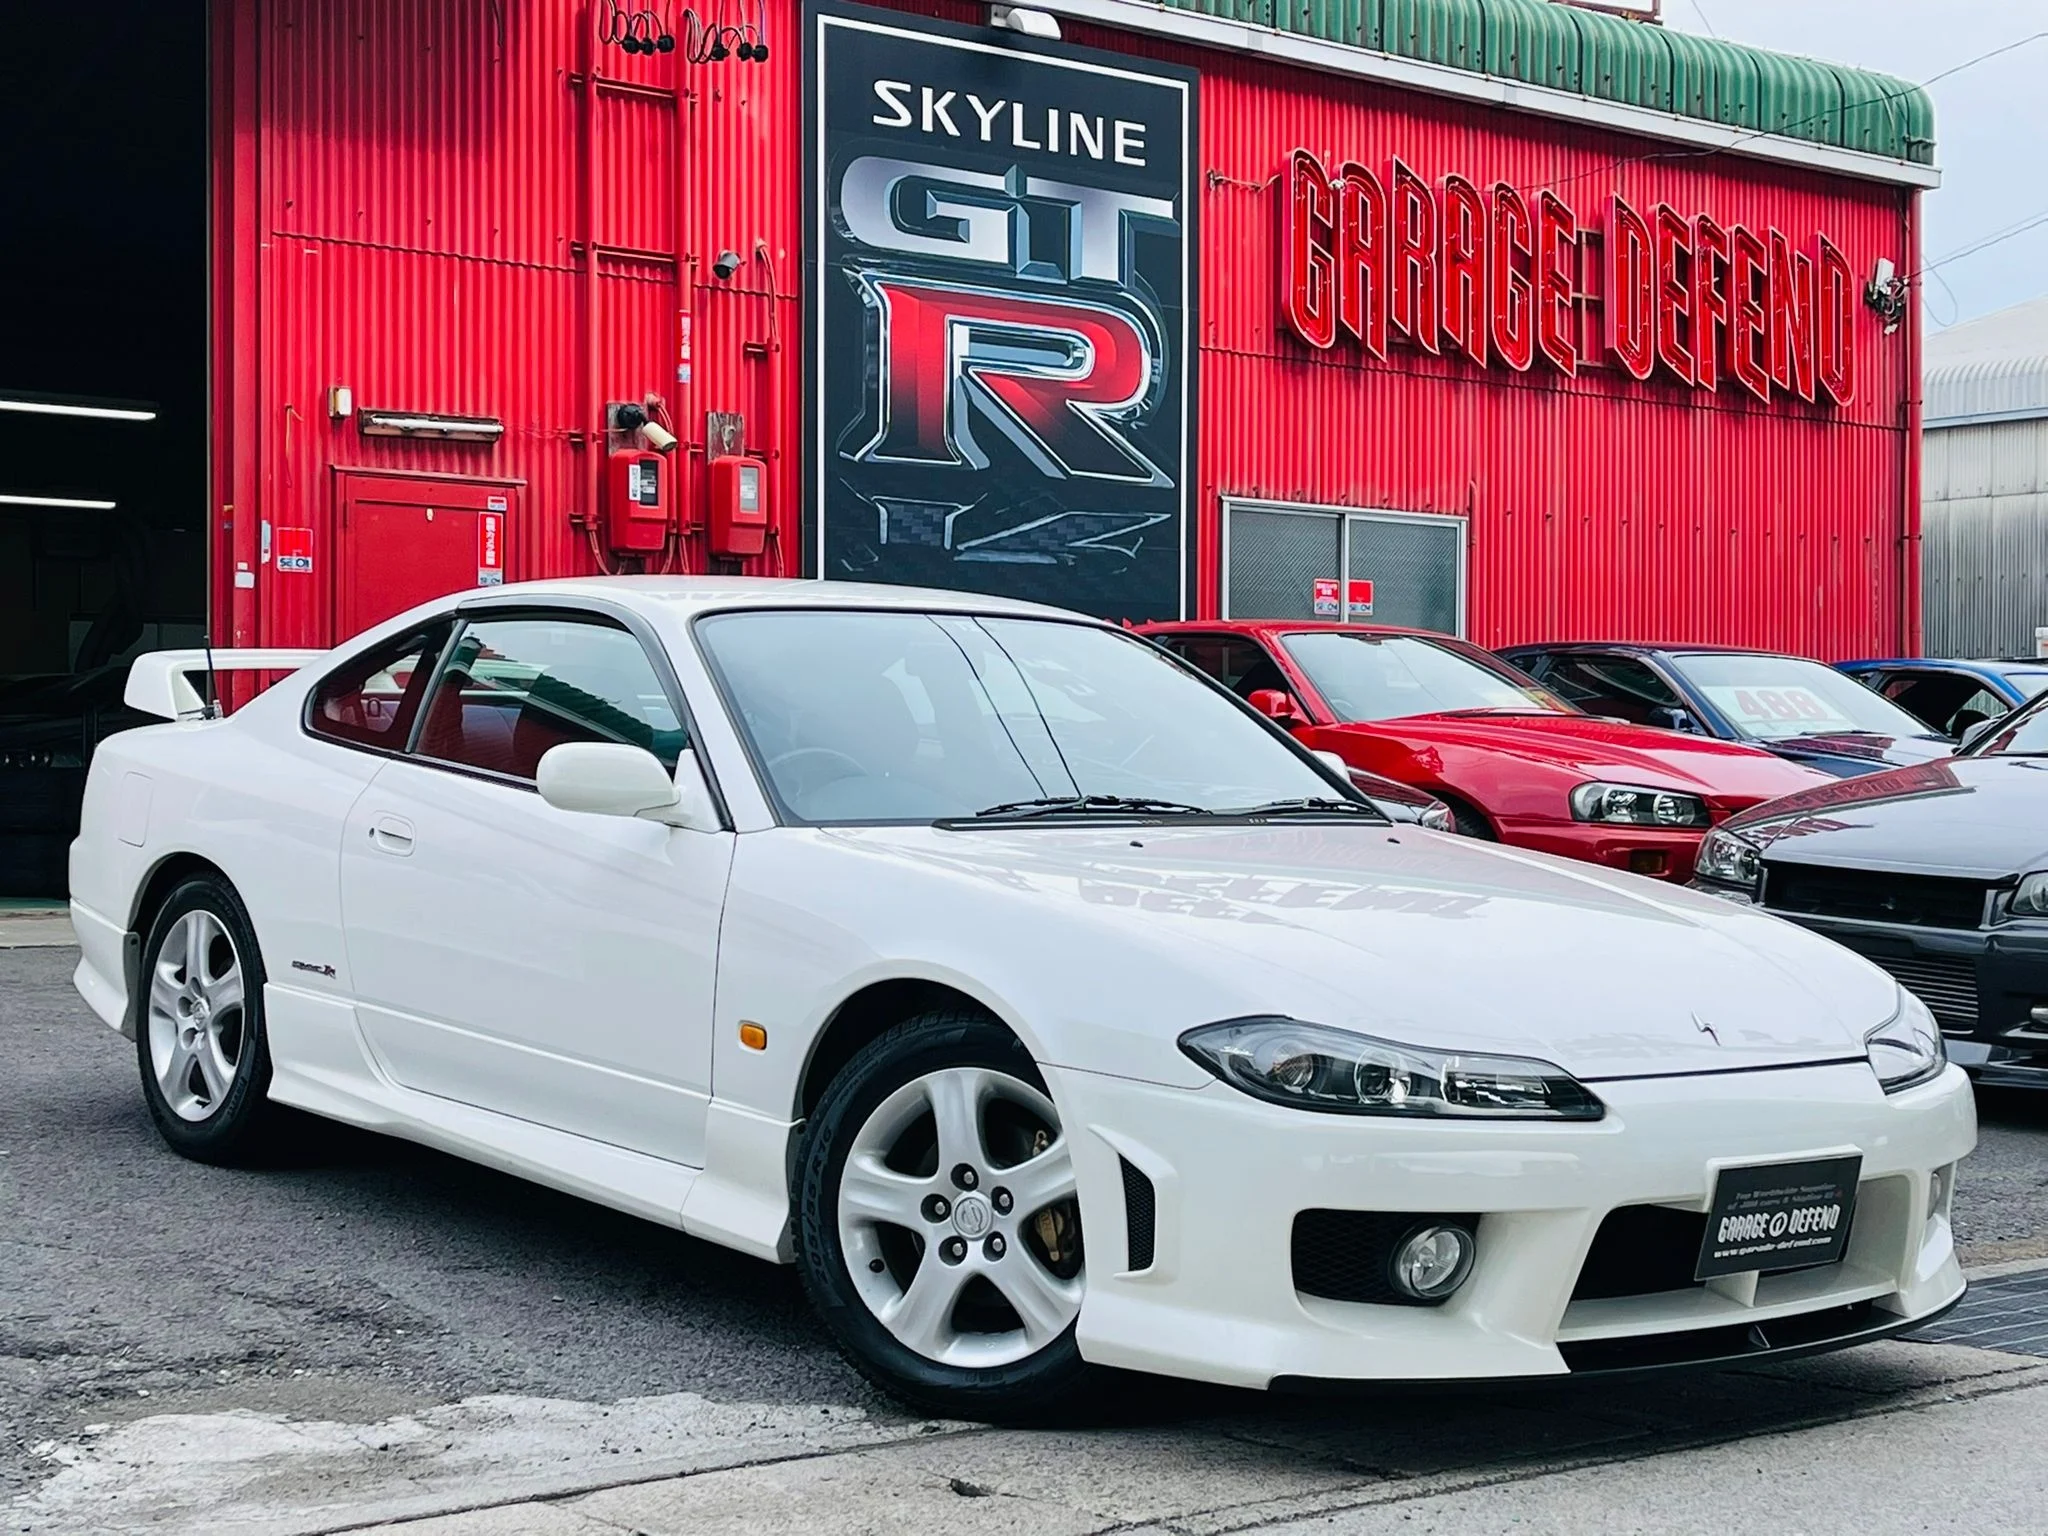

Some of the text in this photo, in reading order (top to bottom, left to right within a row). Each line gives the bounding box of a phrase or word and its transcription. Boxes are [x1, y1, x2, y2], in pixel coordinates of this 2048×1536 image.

[872, 80, 1147, 166] SKYLINE
[1283, 146, 1857, 407] GARAGE DEFEND
[1718, 1204, 1841, 1243] GARAGE DEFEND
